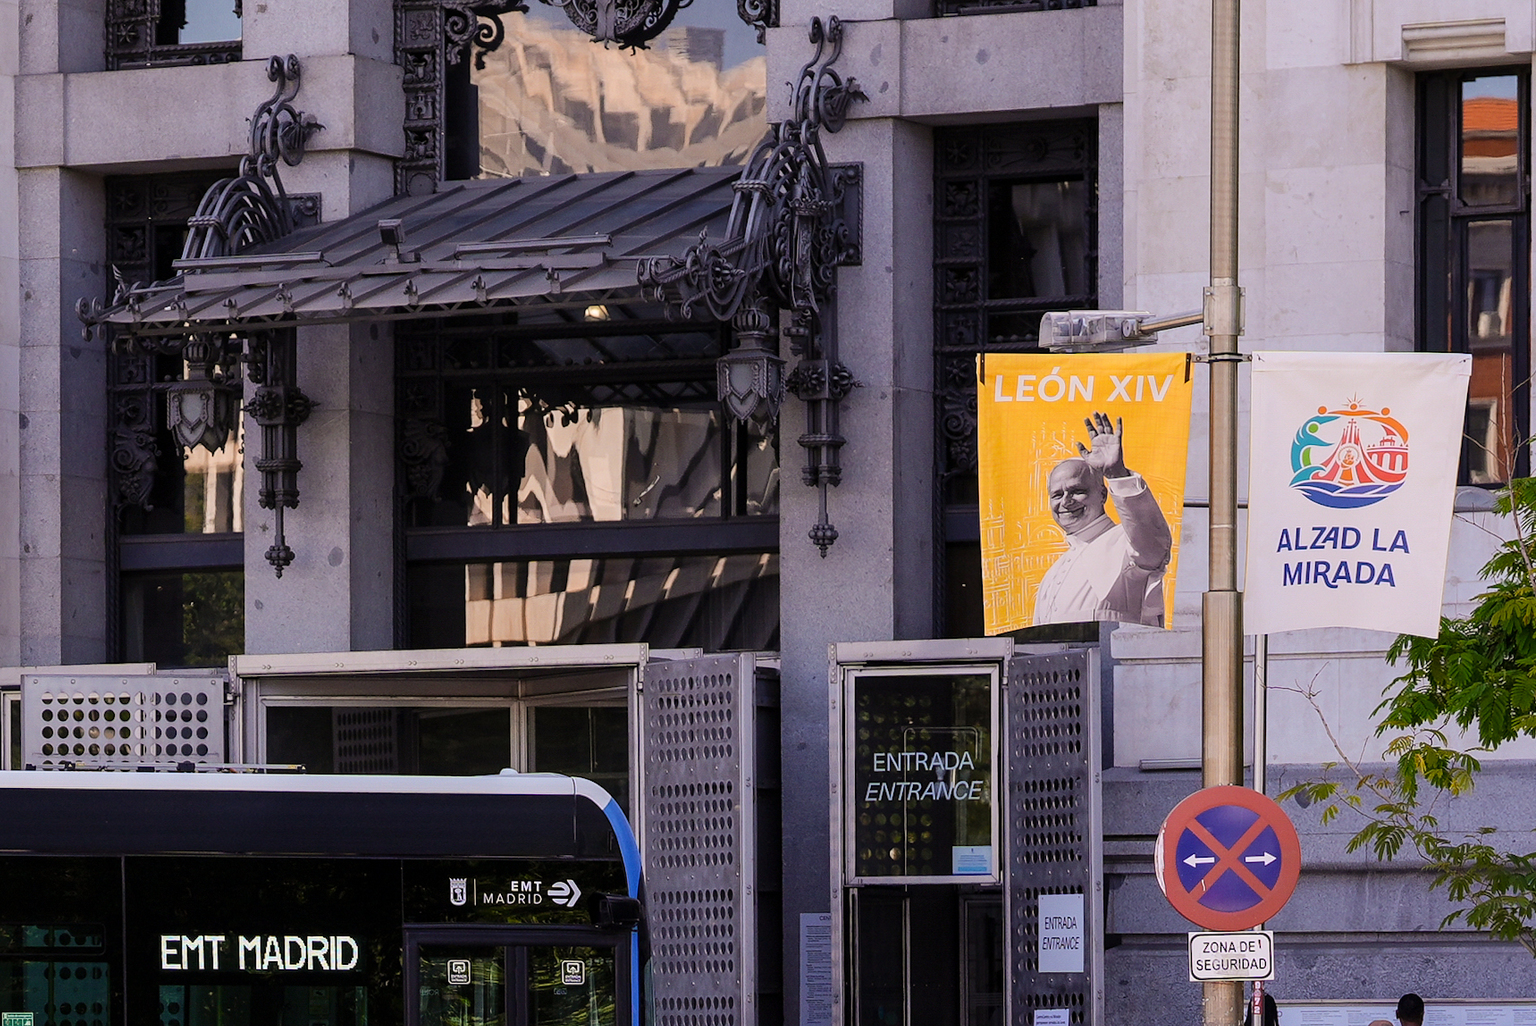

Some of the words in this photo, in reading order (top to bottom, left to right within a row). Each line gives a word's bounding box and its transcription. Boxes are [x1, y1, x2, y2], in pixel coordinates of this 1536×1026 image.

[994, 366, 1093, 403] LEÓN
[1106, 375, 1174, 402] XIV
[1276, 525, 1362, 553] ALZAD
[1371, 528, 1410, 554] LA
[1282, 560, 1396, 589] MIRADA
[873, 751, 975, 772] ENTRADA
[865, 780, 983, 801] ENTRANCE
[511, 881, 542, 892] EMT
[483, 893, 542, 904] MADRID
[1044, 916, 1077, 930] ENTRADA
[1042, 936, 1080, 950] ENTRANCE
[1202, 941, 1237, 953] ZONA
[1239, 941, 1255, 953] DE
[161, 935, 225, 970] EMT
[238, 935, 358, 970] MADRID
[1196, 958, 1267, 971] SEGURIDAD
